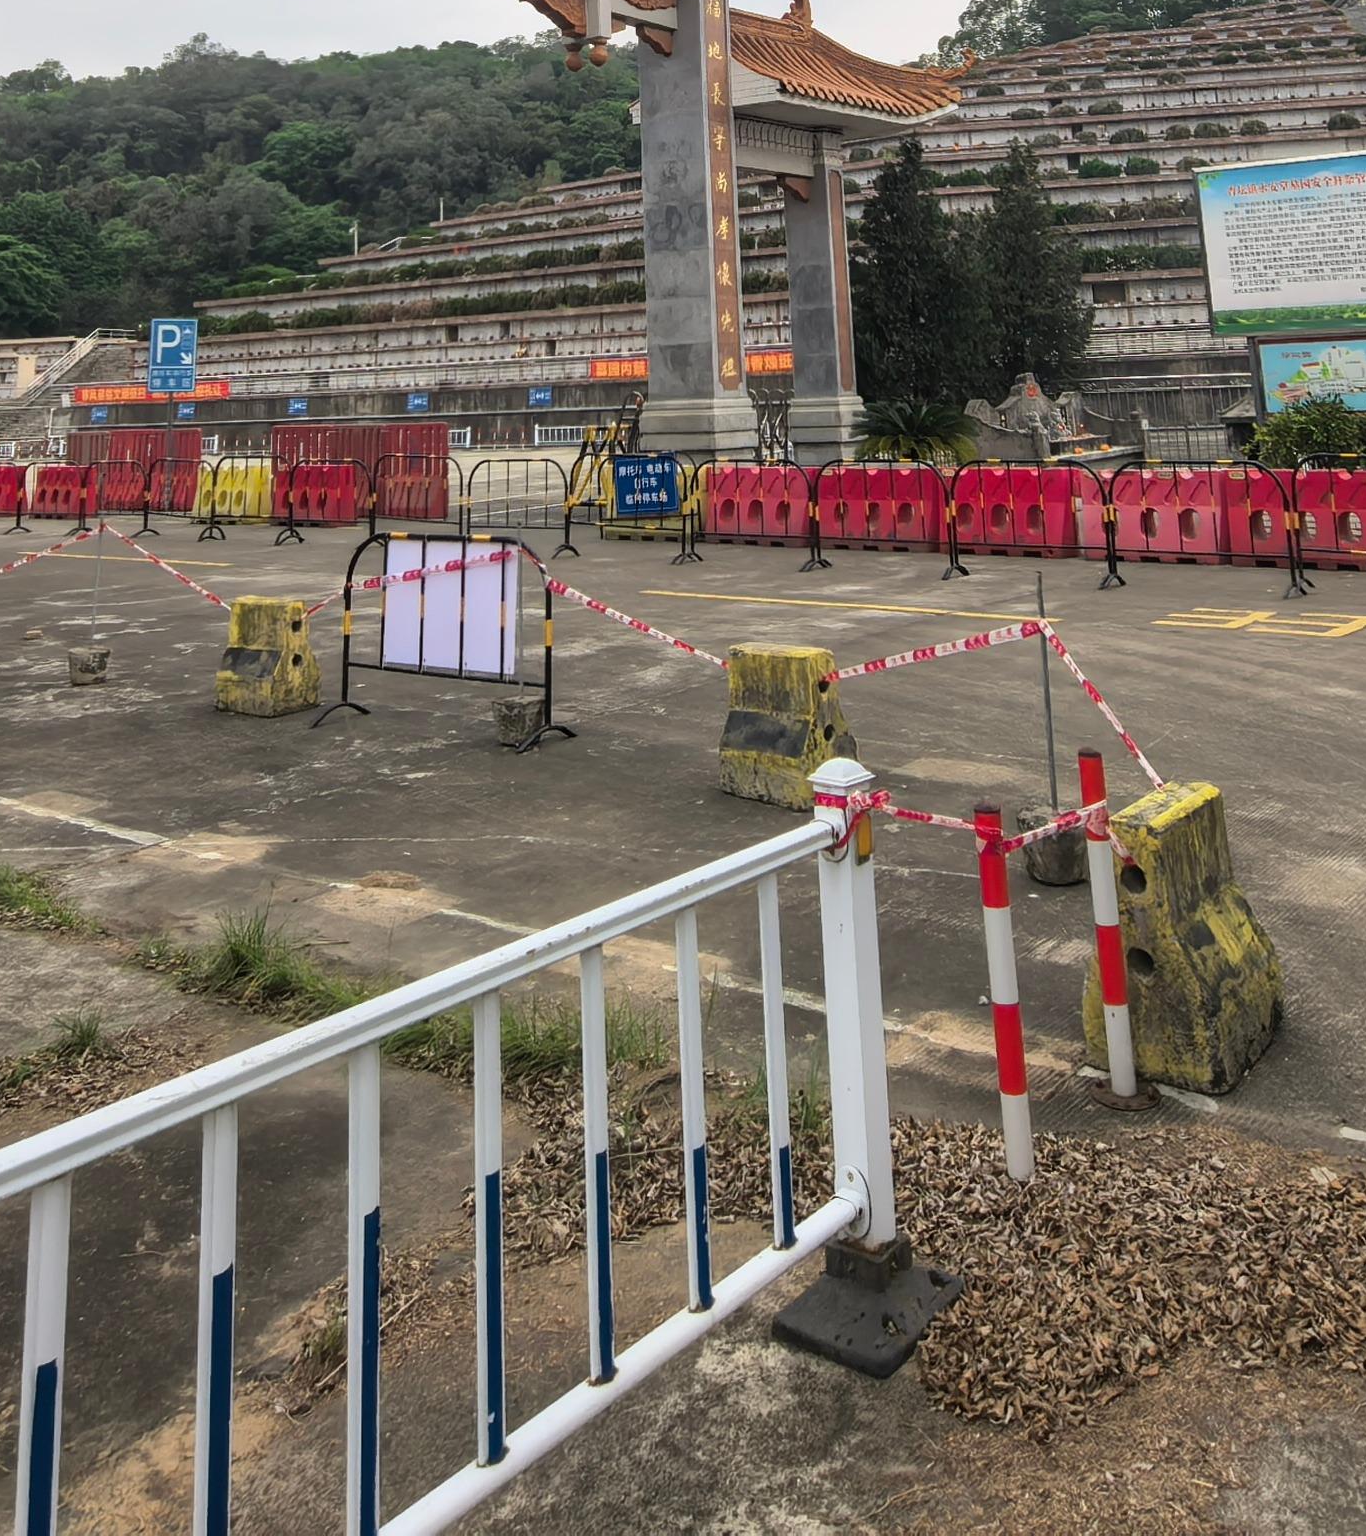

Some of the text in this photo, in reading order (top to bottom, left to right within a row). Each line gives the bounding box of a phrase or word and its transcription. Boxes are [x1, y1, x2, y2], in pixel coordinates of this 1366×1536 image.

[156, 324, 181, 364] P
[646, 463, 672, 474] 电动车
[634, 477, 658, 489] 自行车
[625, 490, 669, 505] 临时停车场
